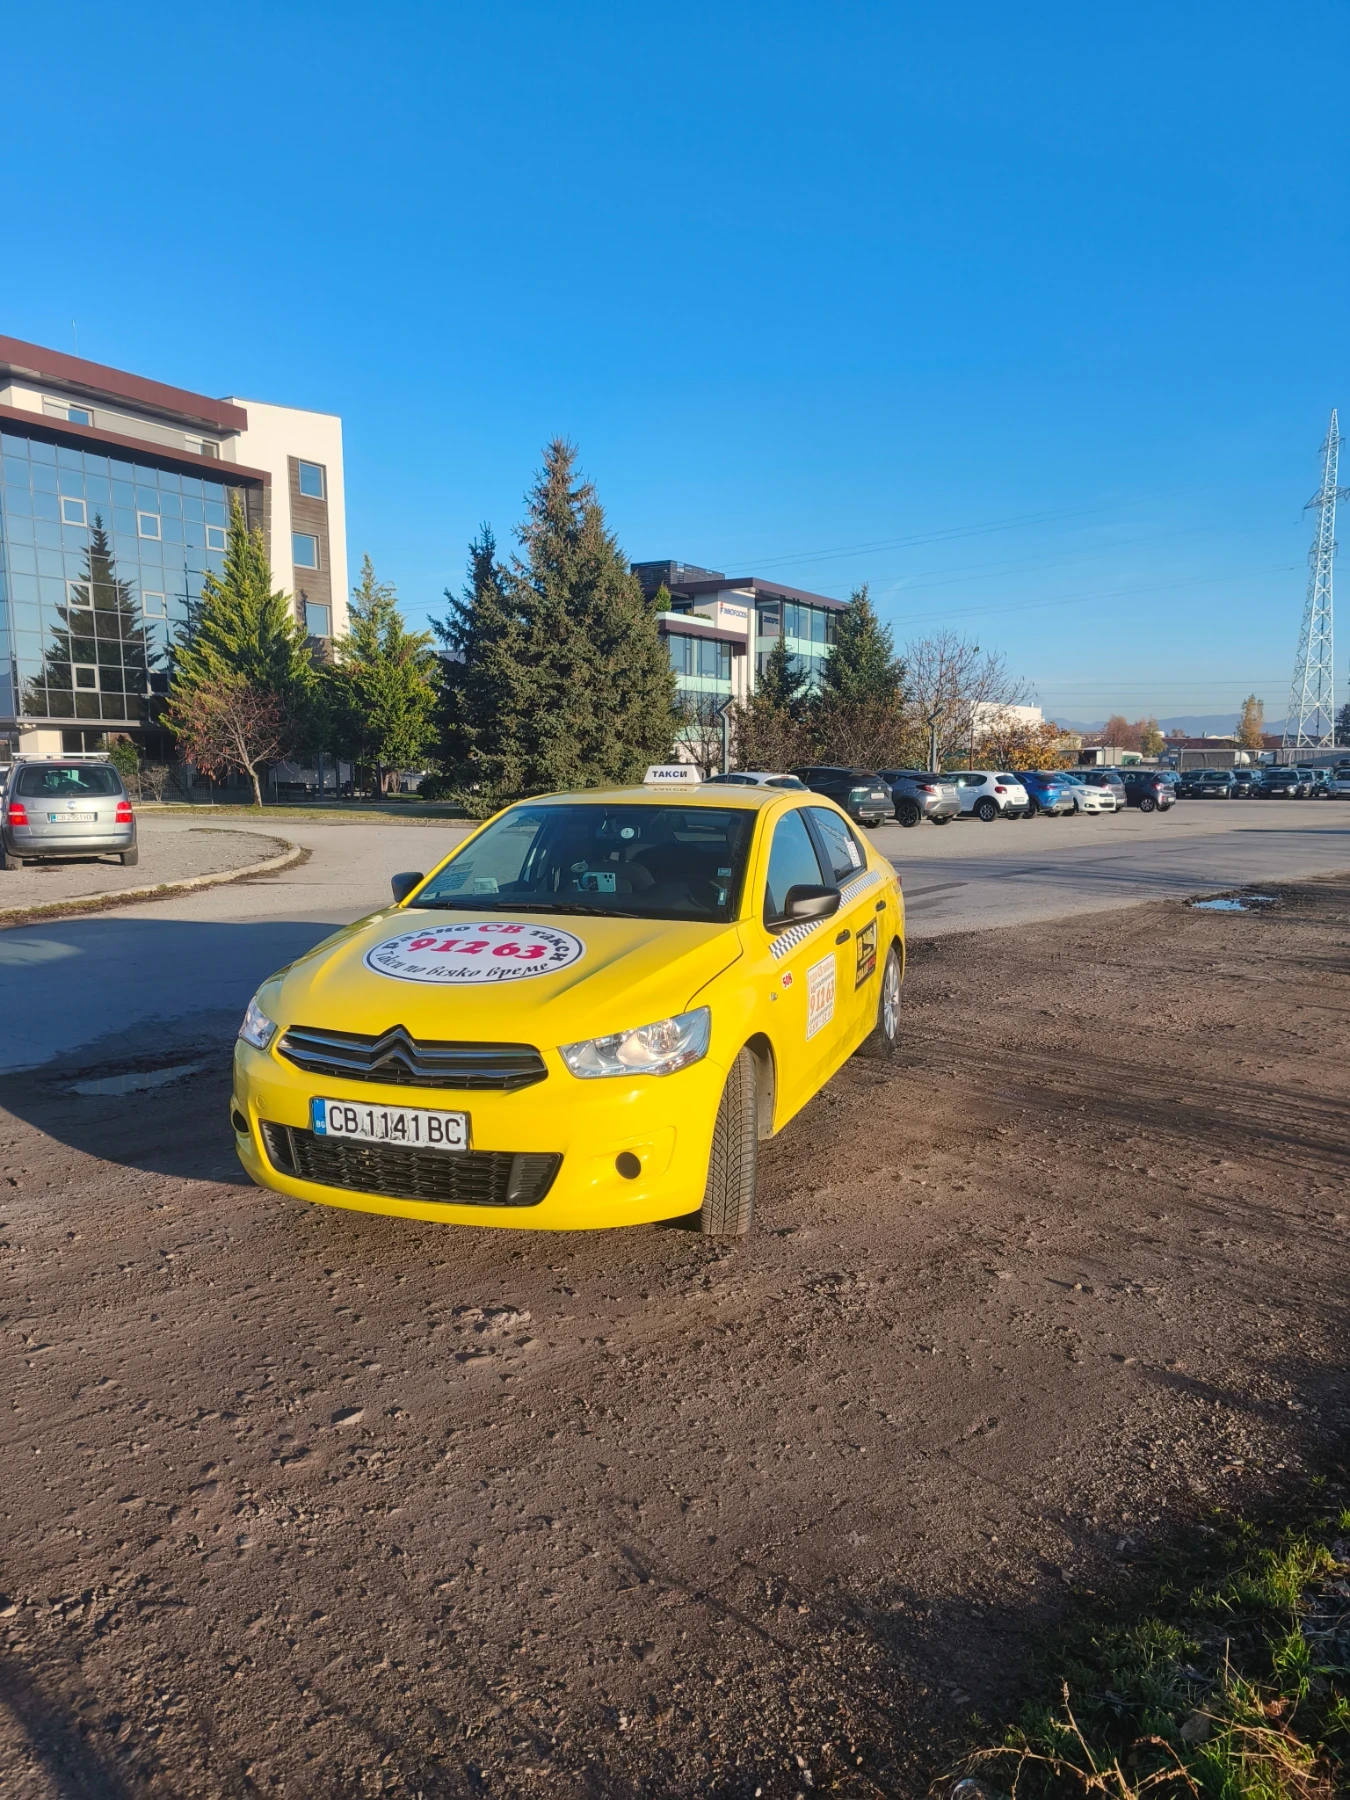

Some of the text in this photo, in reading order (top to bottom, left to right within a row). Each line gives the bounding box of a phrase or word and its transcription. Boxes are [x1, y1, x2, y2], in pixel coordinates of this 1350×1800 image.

[529, 930, 570, 962] такси
[426, 966, 481, 978] всяко
[486, 963, 549, 979] време
[329, 1105, 462, 1145] CB 1141 BC
